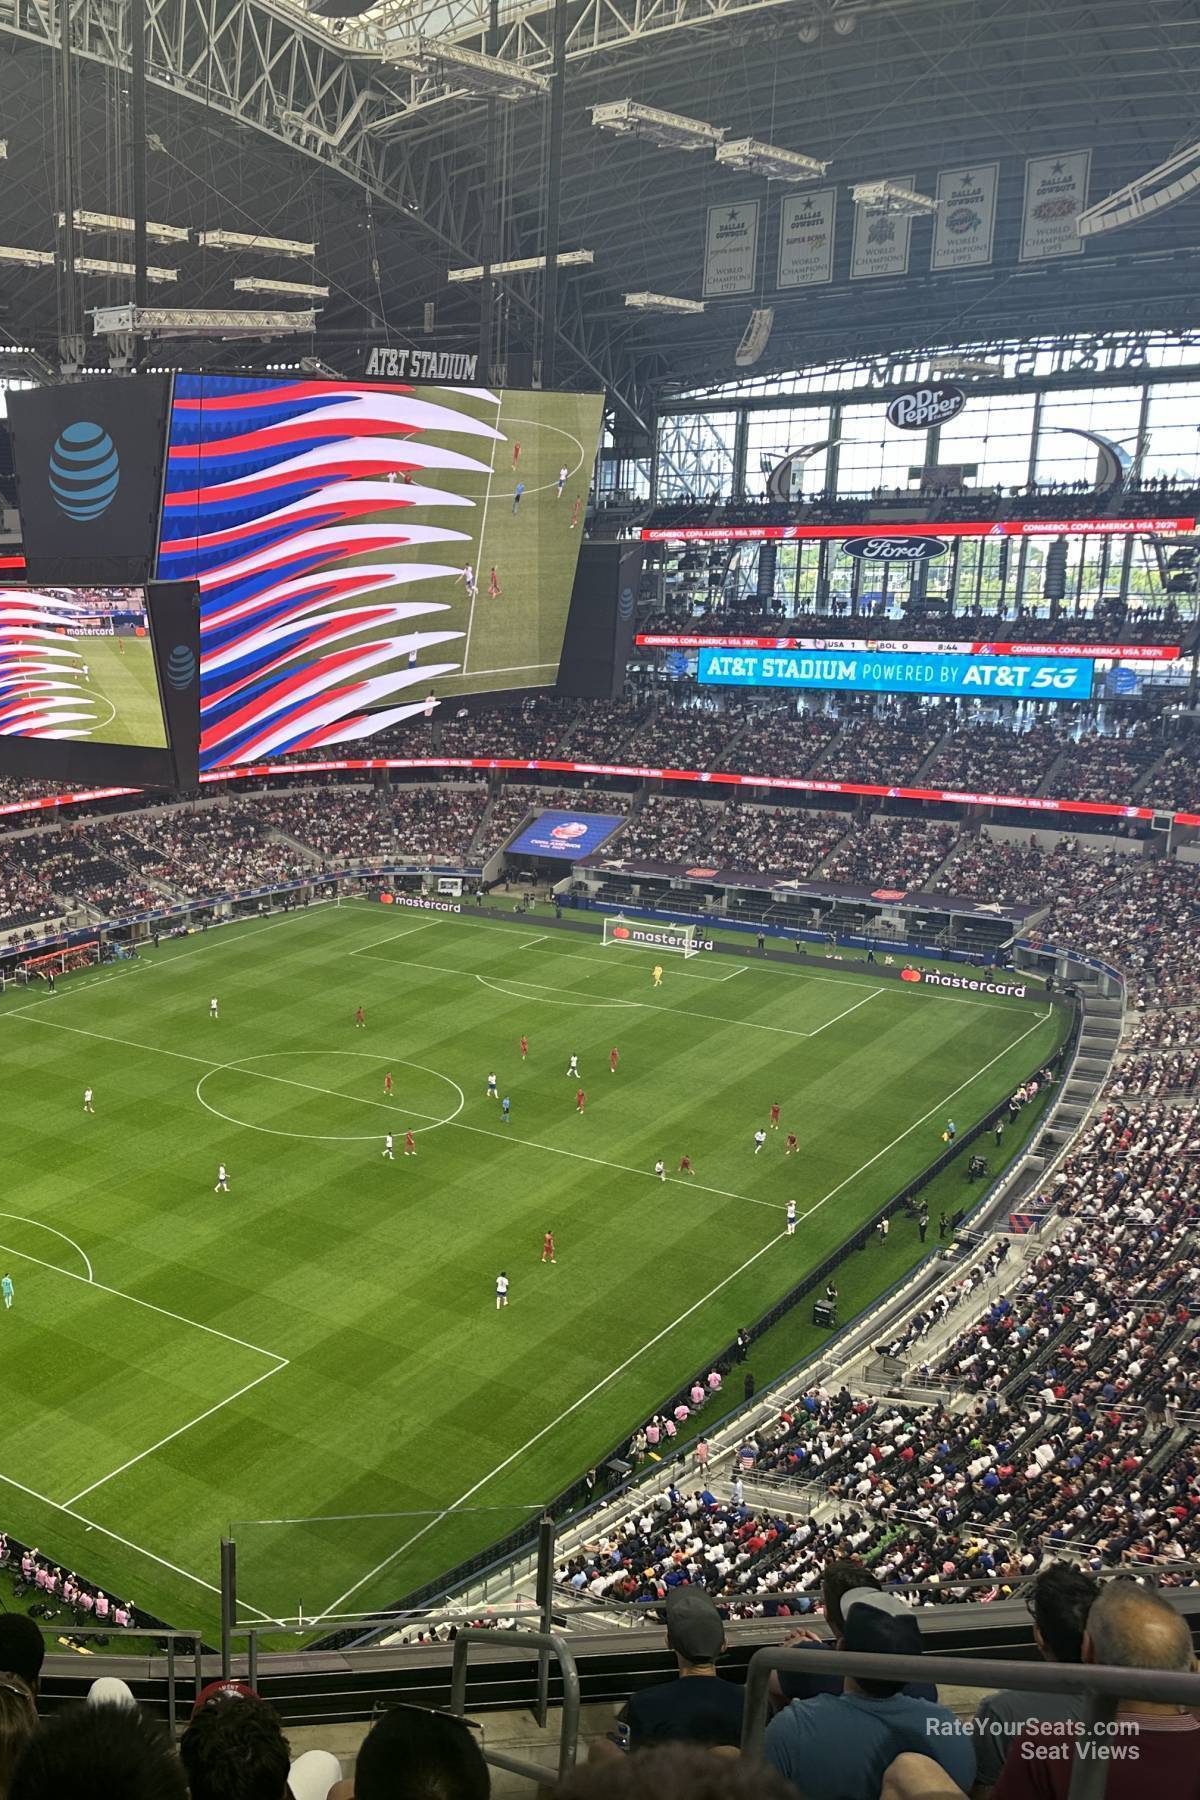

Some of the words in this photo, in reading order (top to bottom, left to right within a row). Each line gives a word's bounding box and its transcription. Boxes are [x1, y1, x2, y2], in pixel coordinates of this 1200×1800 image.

[365, 347, 409, 376] AT&T
[410, 350, 478, 380] STADIUM
[916, 389, 944, 408] Dr
[889, 394, 961, 426] Pepper
[1023, 523, 1069, 532] CONMEBOL
[1071, 523, 1094, 531] COPA
[1095, 522, 1134, 531] AMERICA
[1155, 521, 1178, 531] 2024
[862, 539, 926, 557] Ford
[66, 628, 114, 636] mastercard
[938, 643, 958, 651] 8:44
[1011, 645, 1057, 654] CONMEBOL
[1059, 646, 1082, 656] COPA
[1082, 647, 1120, 656] AMERICA
[1123, 648, 1140, 656] USA
[1142, 648, 1163, 656] 2024
[707, 656, 758, 676] AT&T
[762, 658, 856, 680] STADIUM
[862, 663, 934, 682] POWERED
[940, 666, 958, 682] BY
[962, 665, 1030, 686] AT&T
[1031, 667, 1079, 688] 5G
[395, 896, 461, 913] mastercard
[633, 930, 714, 951] mastercard
[925, 974, 1026, 998] mastercard
